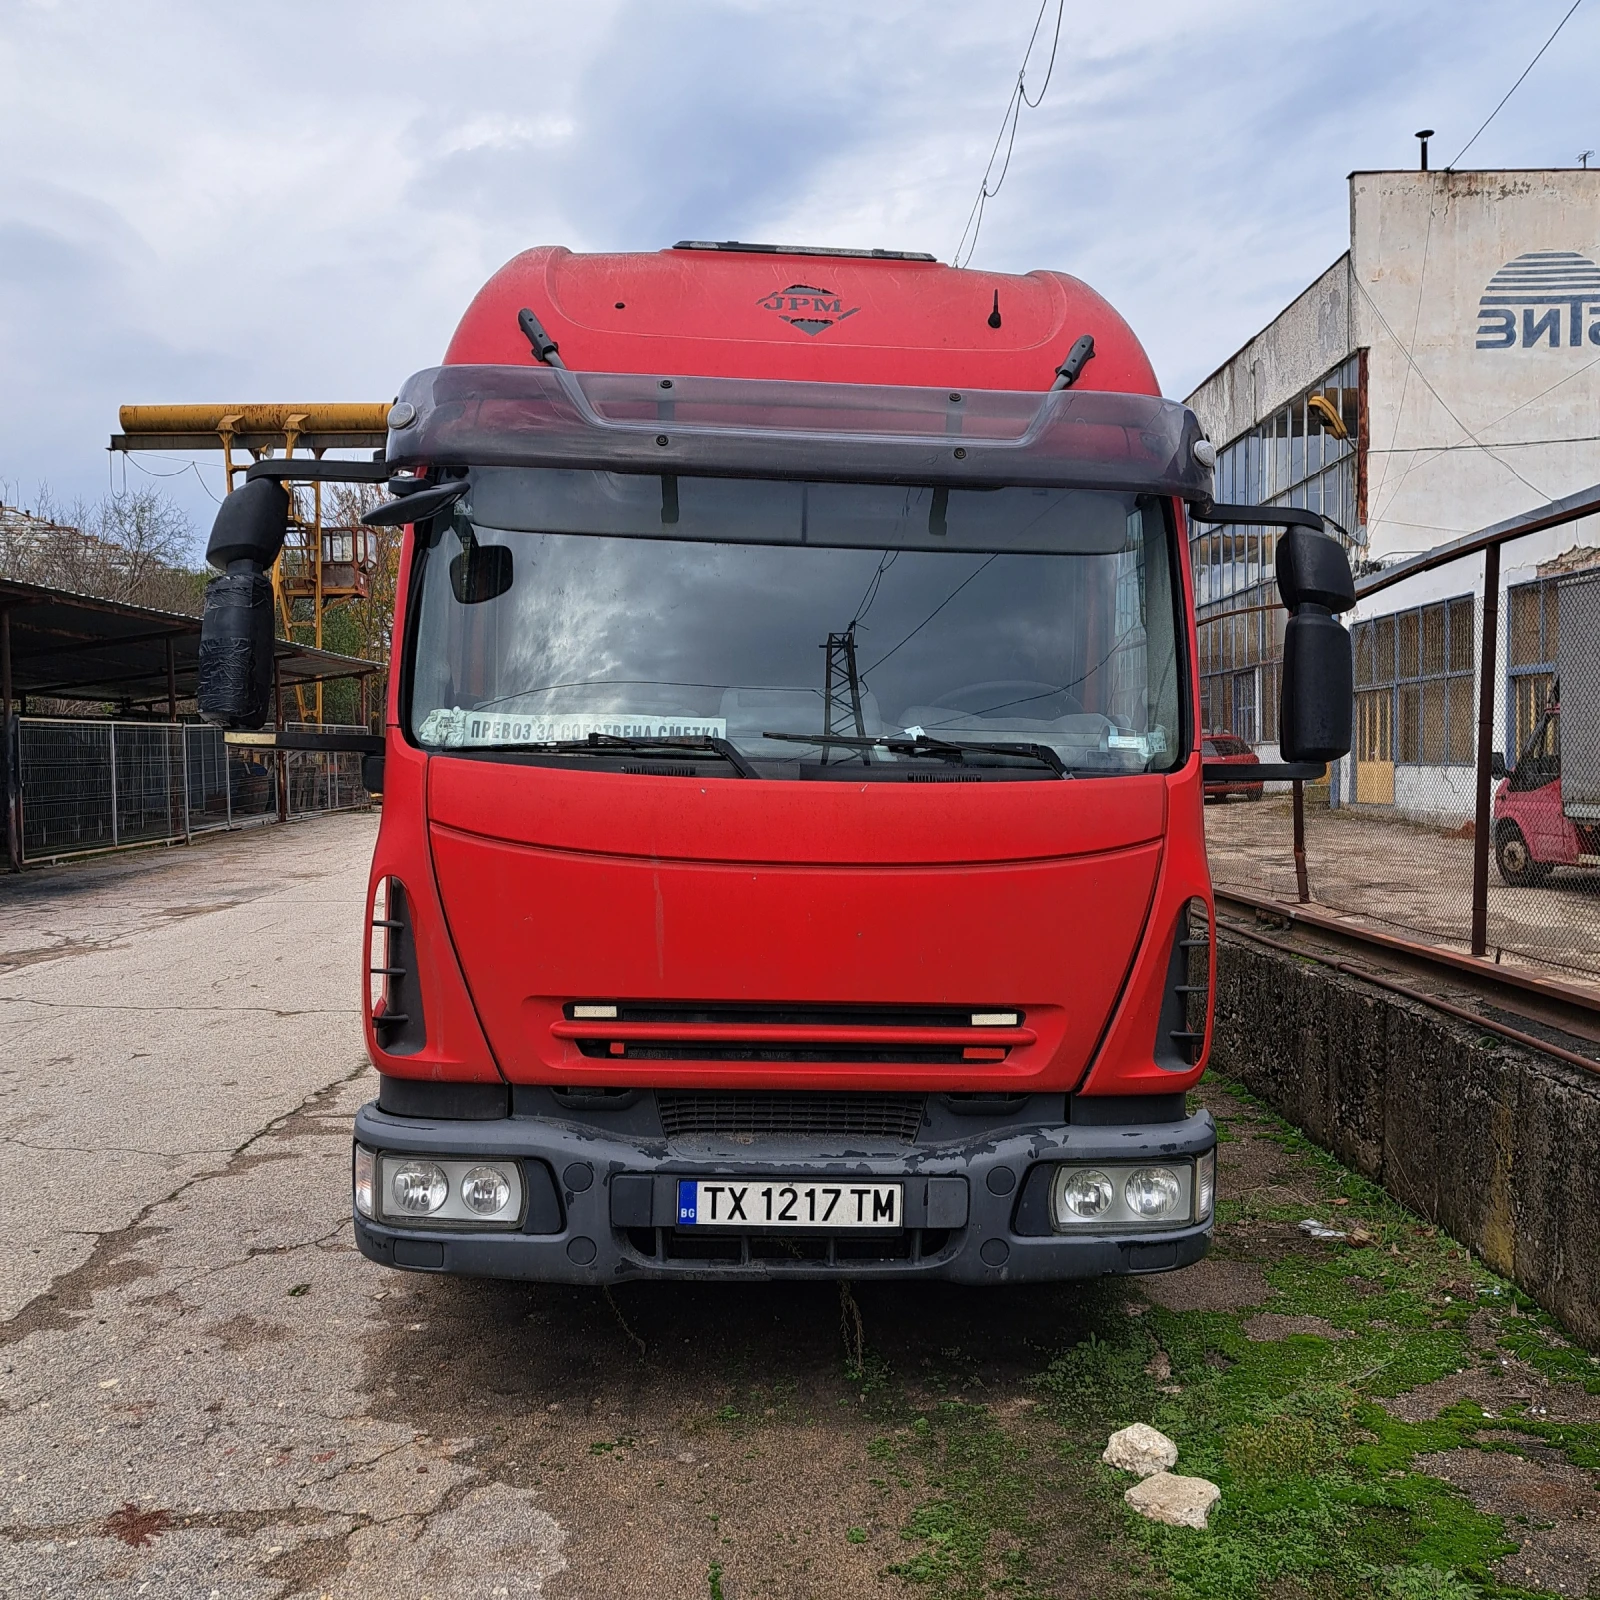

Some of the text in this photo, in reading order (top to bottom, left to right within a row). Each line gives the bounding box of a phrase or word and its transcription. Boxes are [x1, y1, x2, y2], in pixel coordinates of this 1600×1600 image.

[763, 297, 843, 313] JPM
[470, 720, 532, 741] ПРЕВОЗ
[536, 723, 555, 741] ЗА
[680, 1208, 695, 1218] BG
[704, 1186, 895, 1222] TX 1217 TM
